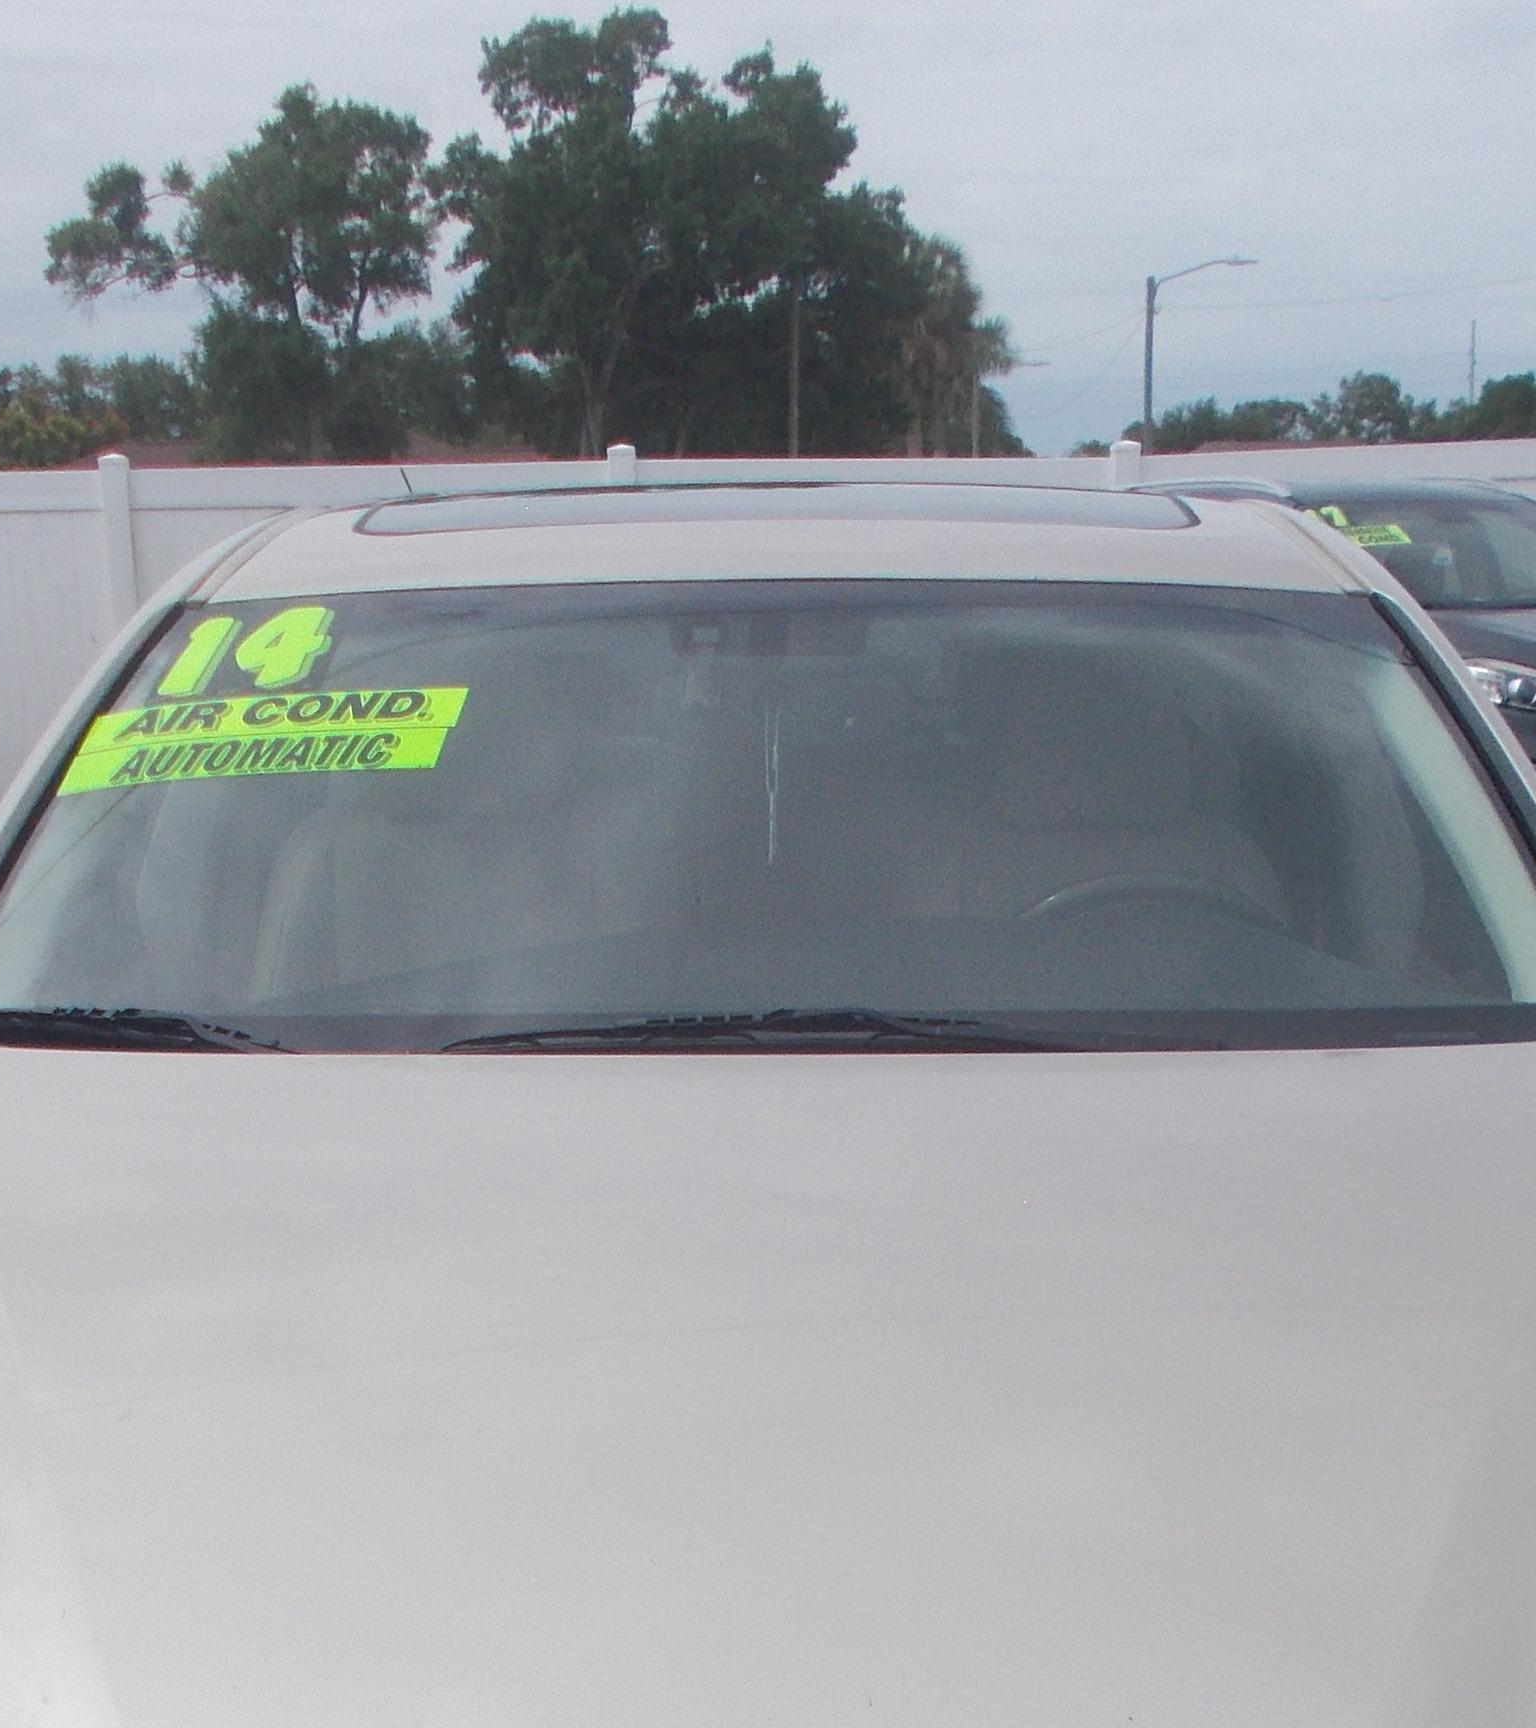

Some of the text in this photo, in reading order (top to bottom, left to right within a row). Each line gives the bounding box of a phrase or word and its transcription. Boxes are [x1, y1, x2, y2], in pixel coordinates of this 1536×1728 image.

[156, 606, 335, 697] 14
[112, 690, 434, 743] AIR COND.
[108, 732, 403, 785] AUTOMATIC
